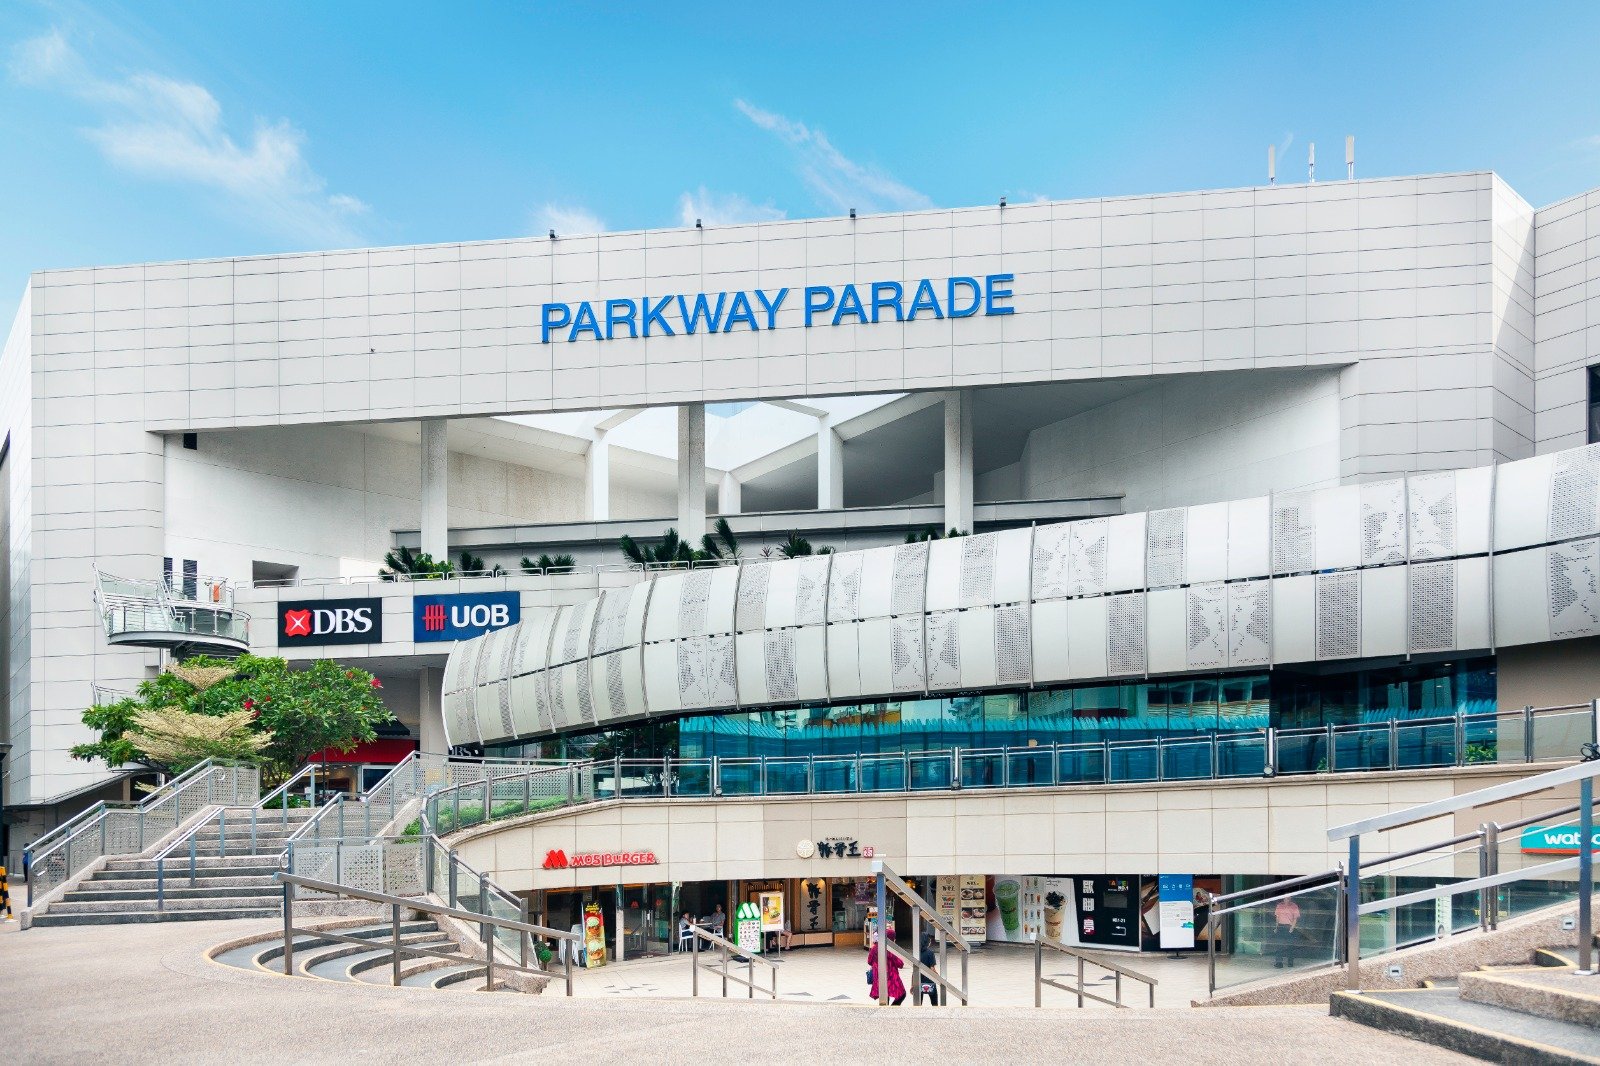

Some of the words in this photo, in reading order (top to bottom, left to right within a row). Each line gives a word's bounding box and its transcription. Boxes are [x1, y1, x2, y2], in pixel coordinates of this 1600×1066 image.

[541, 287, 789, 343] PARKWAY
[804, 273, 1015, 328] PARADE
[312, 607, 373, 635] DBS
[451, 604, 510, 628] UOB
[571, 853, 602, 867] MOS
[602, 852, 656, 867] BURGER
